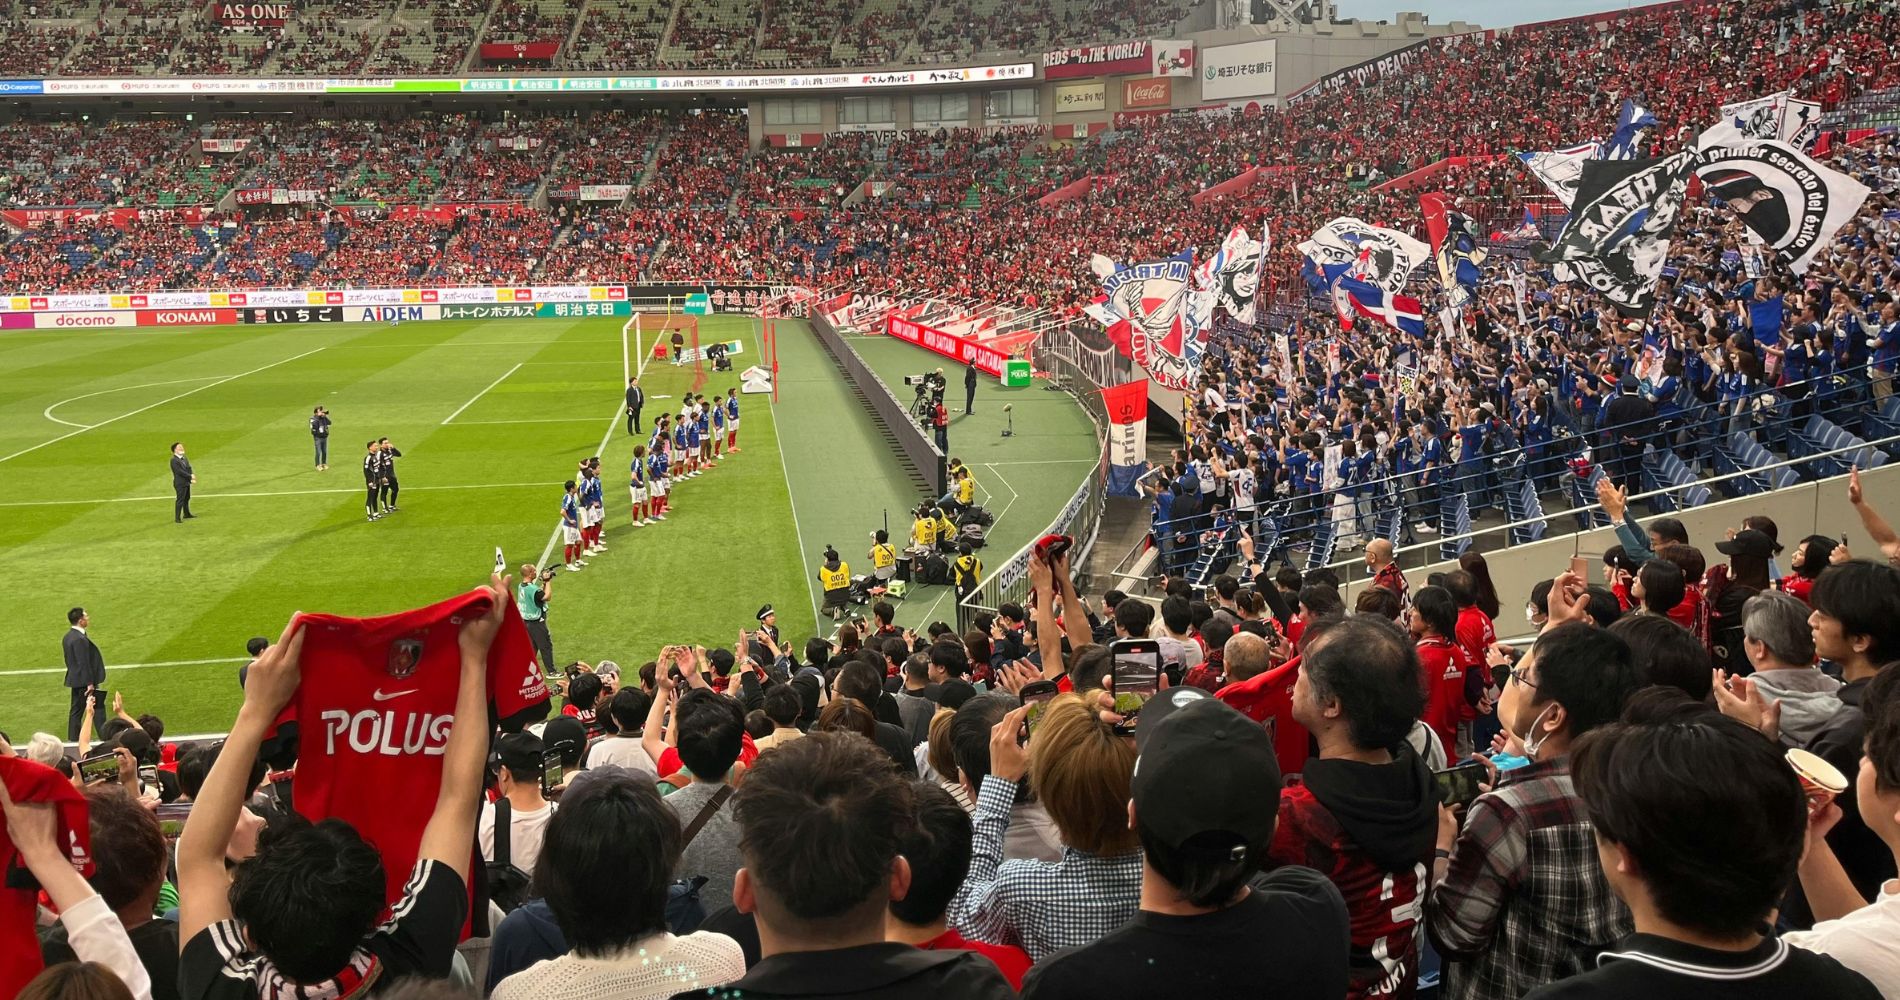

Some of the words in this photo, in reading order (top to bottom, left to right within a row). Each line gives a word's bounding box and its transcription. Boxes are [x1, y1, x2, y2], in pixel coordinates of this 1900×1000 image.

[222, 3, 245, 19] AS
[252, 3, 289, 19] ONE
[1043, 51, 1069, 68] REDS
[1071, 49, 1082, 59] GO
[1088, 46, 1107, 63] THE
[1107, 41, 1147, 60] WORLD!
[1218, 62, 1272, 78] 埼玉りそな銀行
[570, 80, 601, 89] 明治安田
[619, 80, 651, 88] 明治安田
[1325, 73, 1346, 93] ARE
[1348, 64, 1374, 86] YOU
[471, 81, 503, 89] 明治安田
[521, 81, 552, 89] 明治安田
[1769, 152, 1816, 191] secreto
[1808, 191, 1825, 212] del
[252, 295, 288, 304] スポーツくじ
[348, 293, 384, 303] スポーツくじ
[443, 291, 478, 300] スポーツくじ
[536, 289, 571, 299] スポーツくじ
[54, 299, 91, 308] スポーツくじ
[153, 297, 190, 306] スポーツくじ
[273, 308, 332, 322] いちご
[362, 307, 422, 321] AiDEM
[442, 305, 535, 318] ルートインホテルズ
[555, 303, 614, 316] 明治安田
[56, 313, 115, 326] docomo
[156, 312, 216, 323] KONAMI
[924, 331, 936, 347] KIRIN
[936, 334, 956, 354] SAITAMA
[831, 573, 845, 582] 002
[321, 709, 456, 756] POLUS
